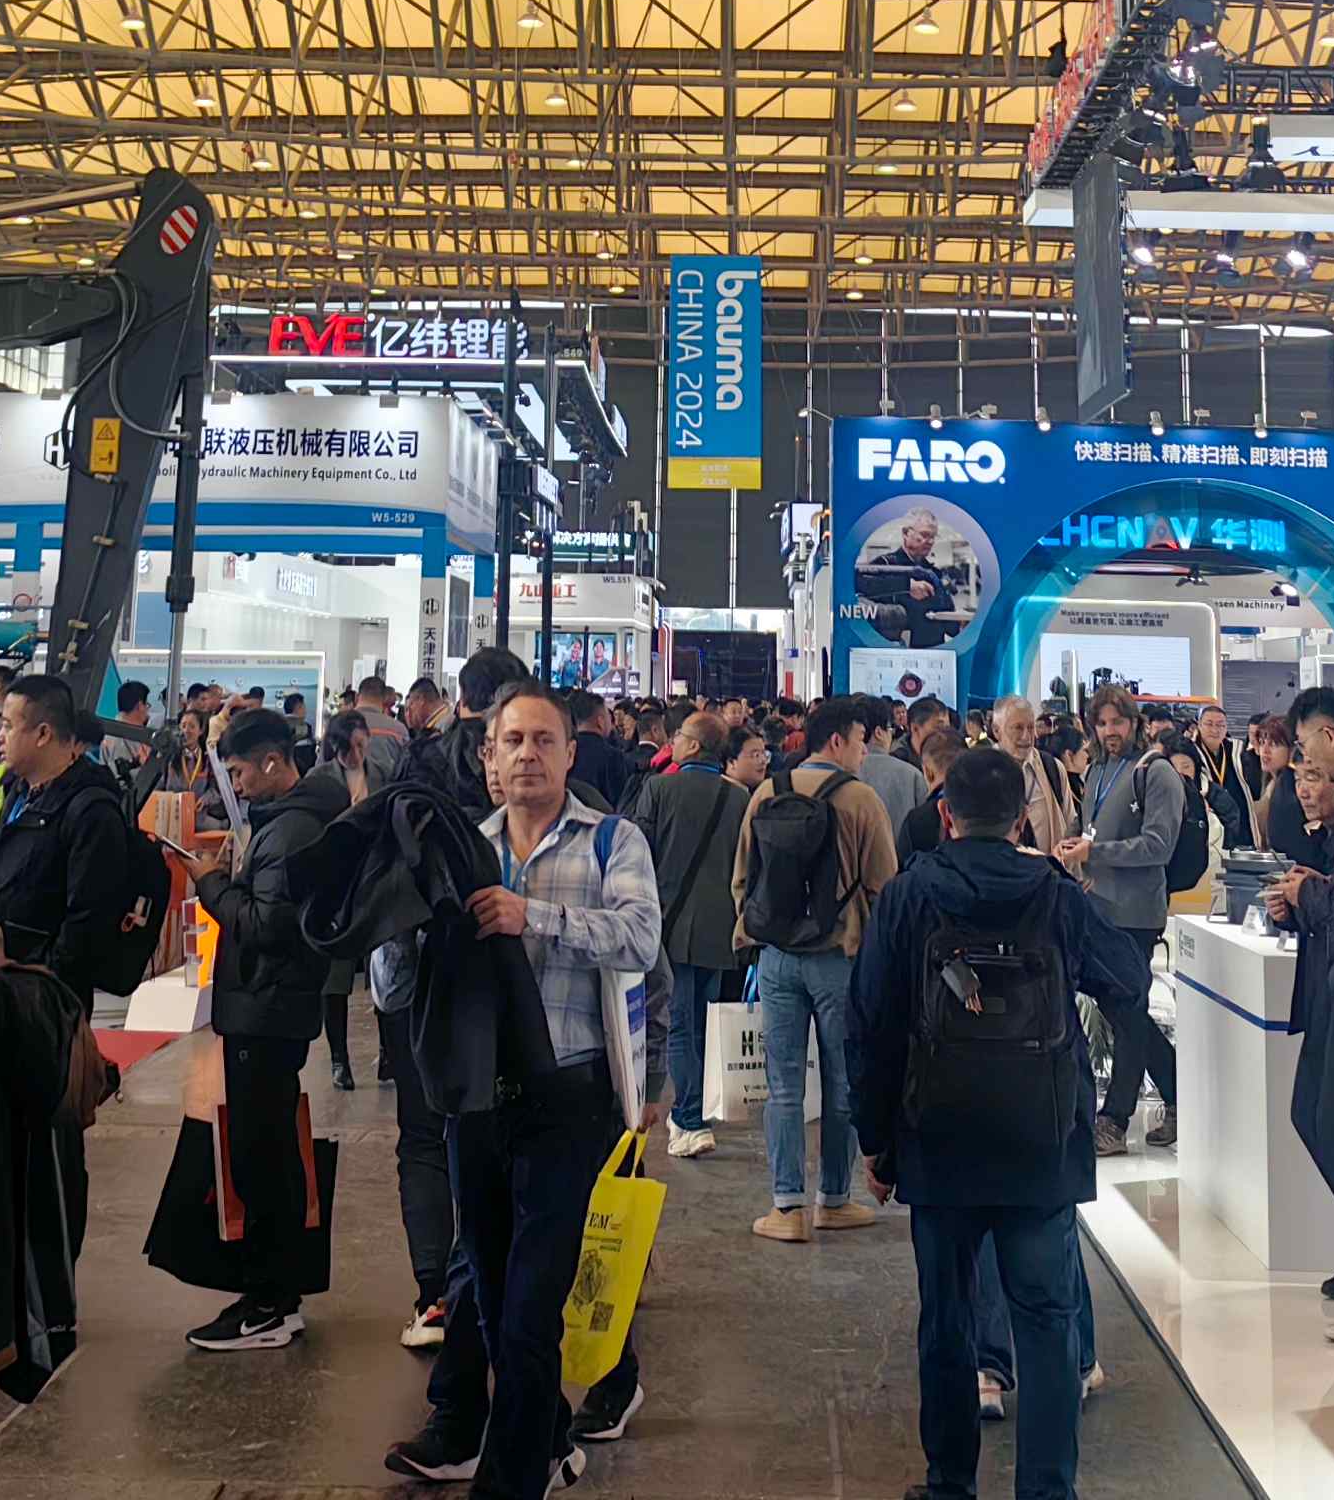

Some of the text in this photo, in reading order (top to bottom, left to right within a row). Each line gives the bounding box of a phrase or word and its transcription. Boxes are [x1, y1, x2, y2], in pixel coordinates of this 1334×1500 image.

[269, 311, 366, 356] EVE
[716, 270, 758, 411] bauma
[675, 269, 704, 450] CHINA 2024
[198, 466, 417, 482] ydraulic Machinery Equipment Co., Ltd
[858, 437, 1006, 485] FARO
[1210, 518, 1286, 551] 华测
[839, 603, 879, 620] NEW
[1236, 600, 1285, 611] Machinery
